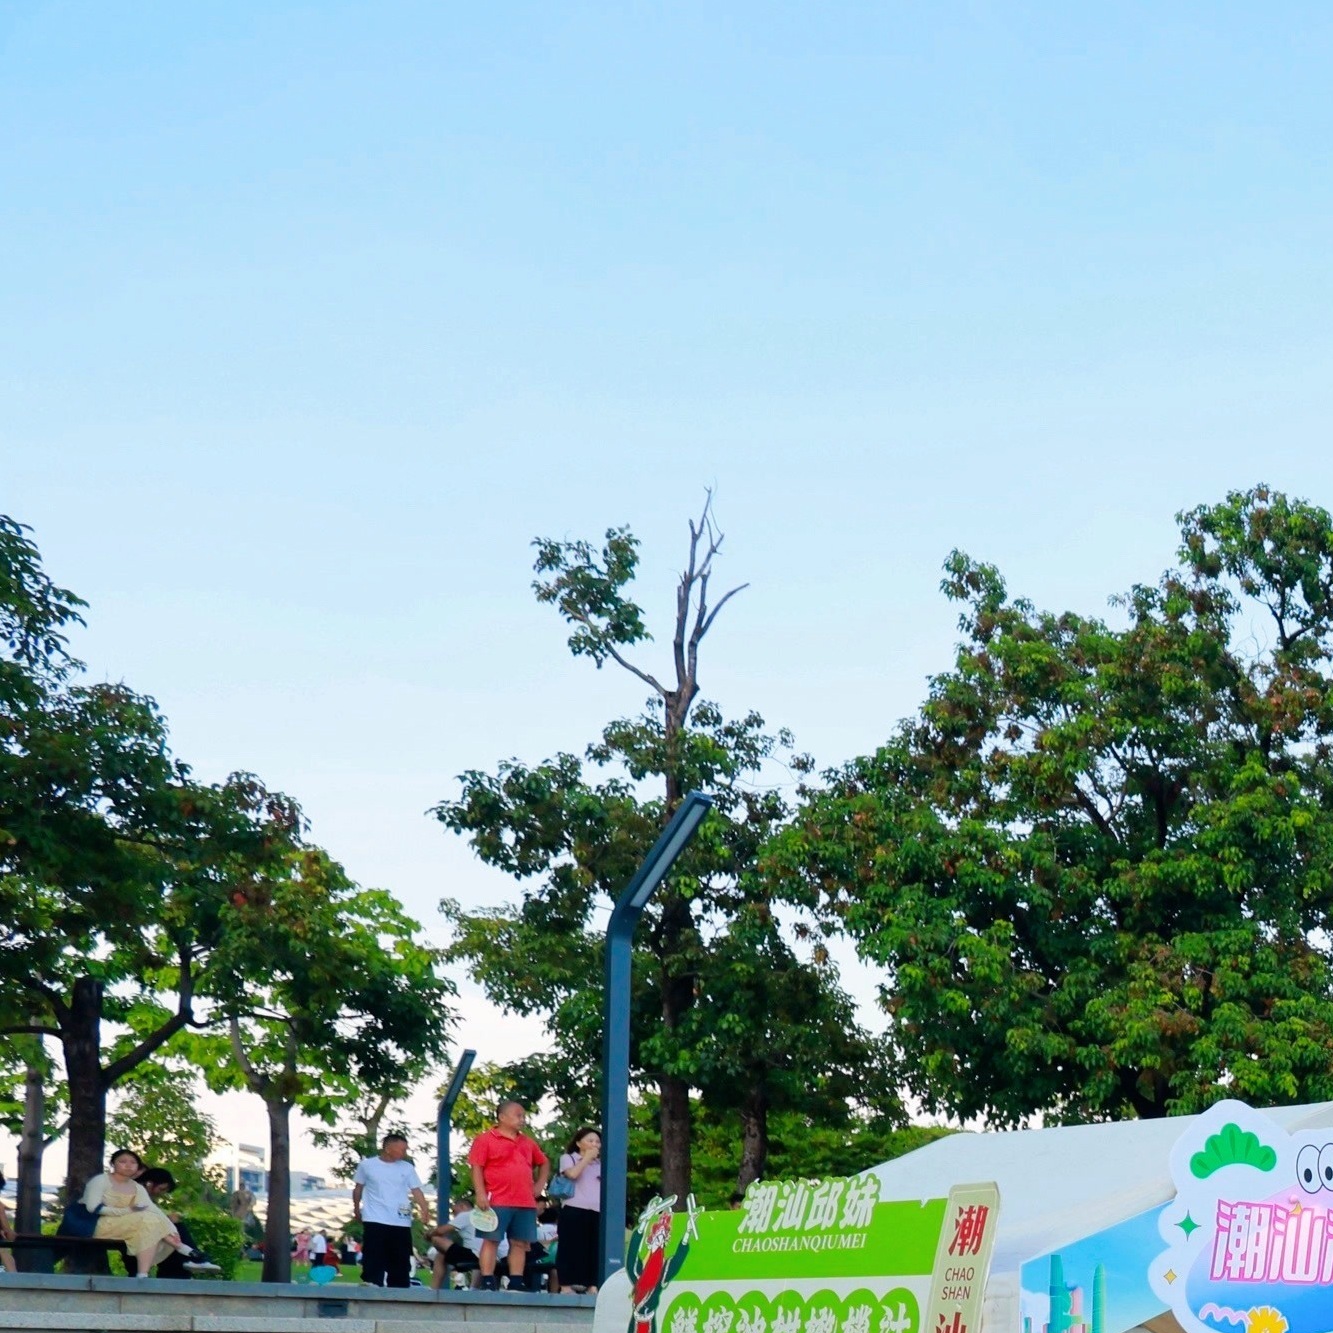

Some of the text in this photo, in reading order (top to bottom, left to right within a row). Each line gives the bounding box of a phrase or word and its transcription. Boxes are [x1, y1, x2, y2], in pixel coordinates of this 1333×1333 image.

[738, 1178, 878, 1233] 潮汕邱妹
[733, 1233, 867, 1253] CHAOSHANQIUMEI
[945, 1267, 974, 1281] CHAO
[941, 1286, 971, 1300] SHAN
